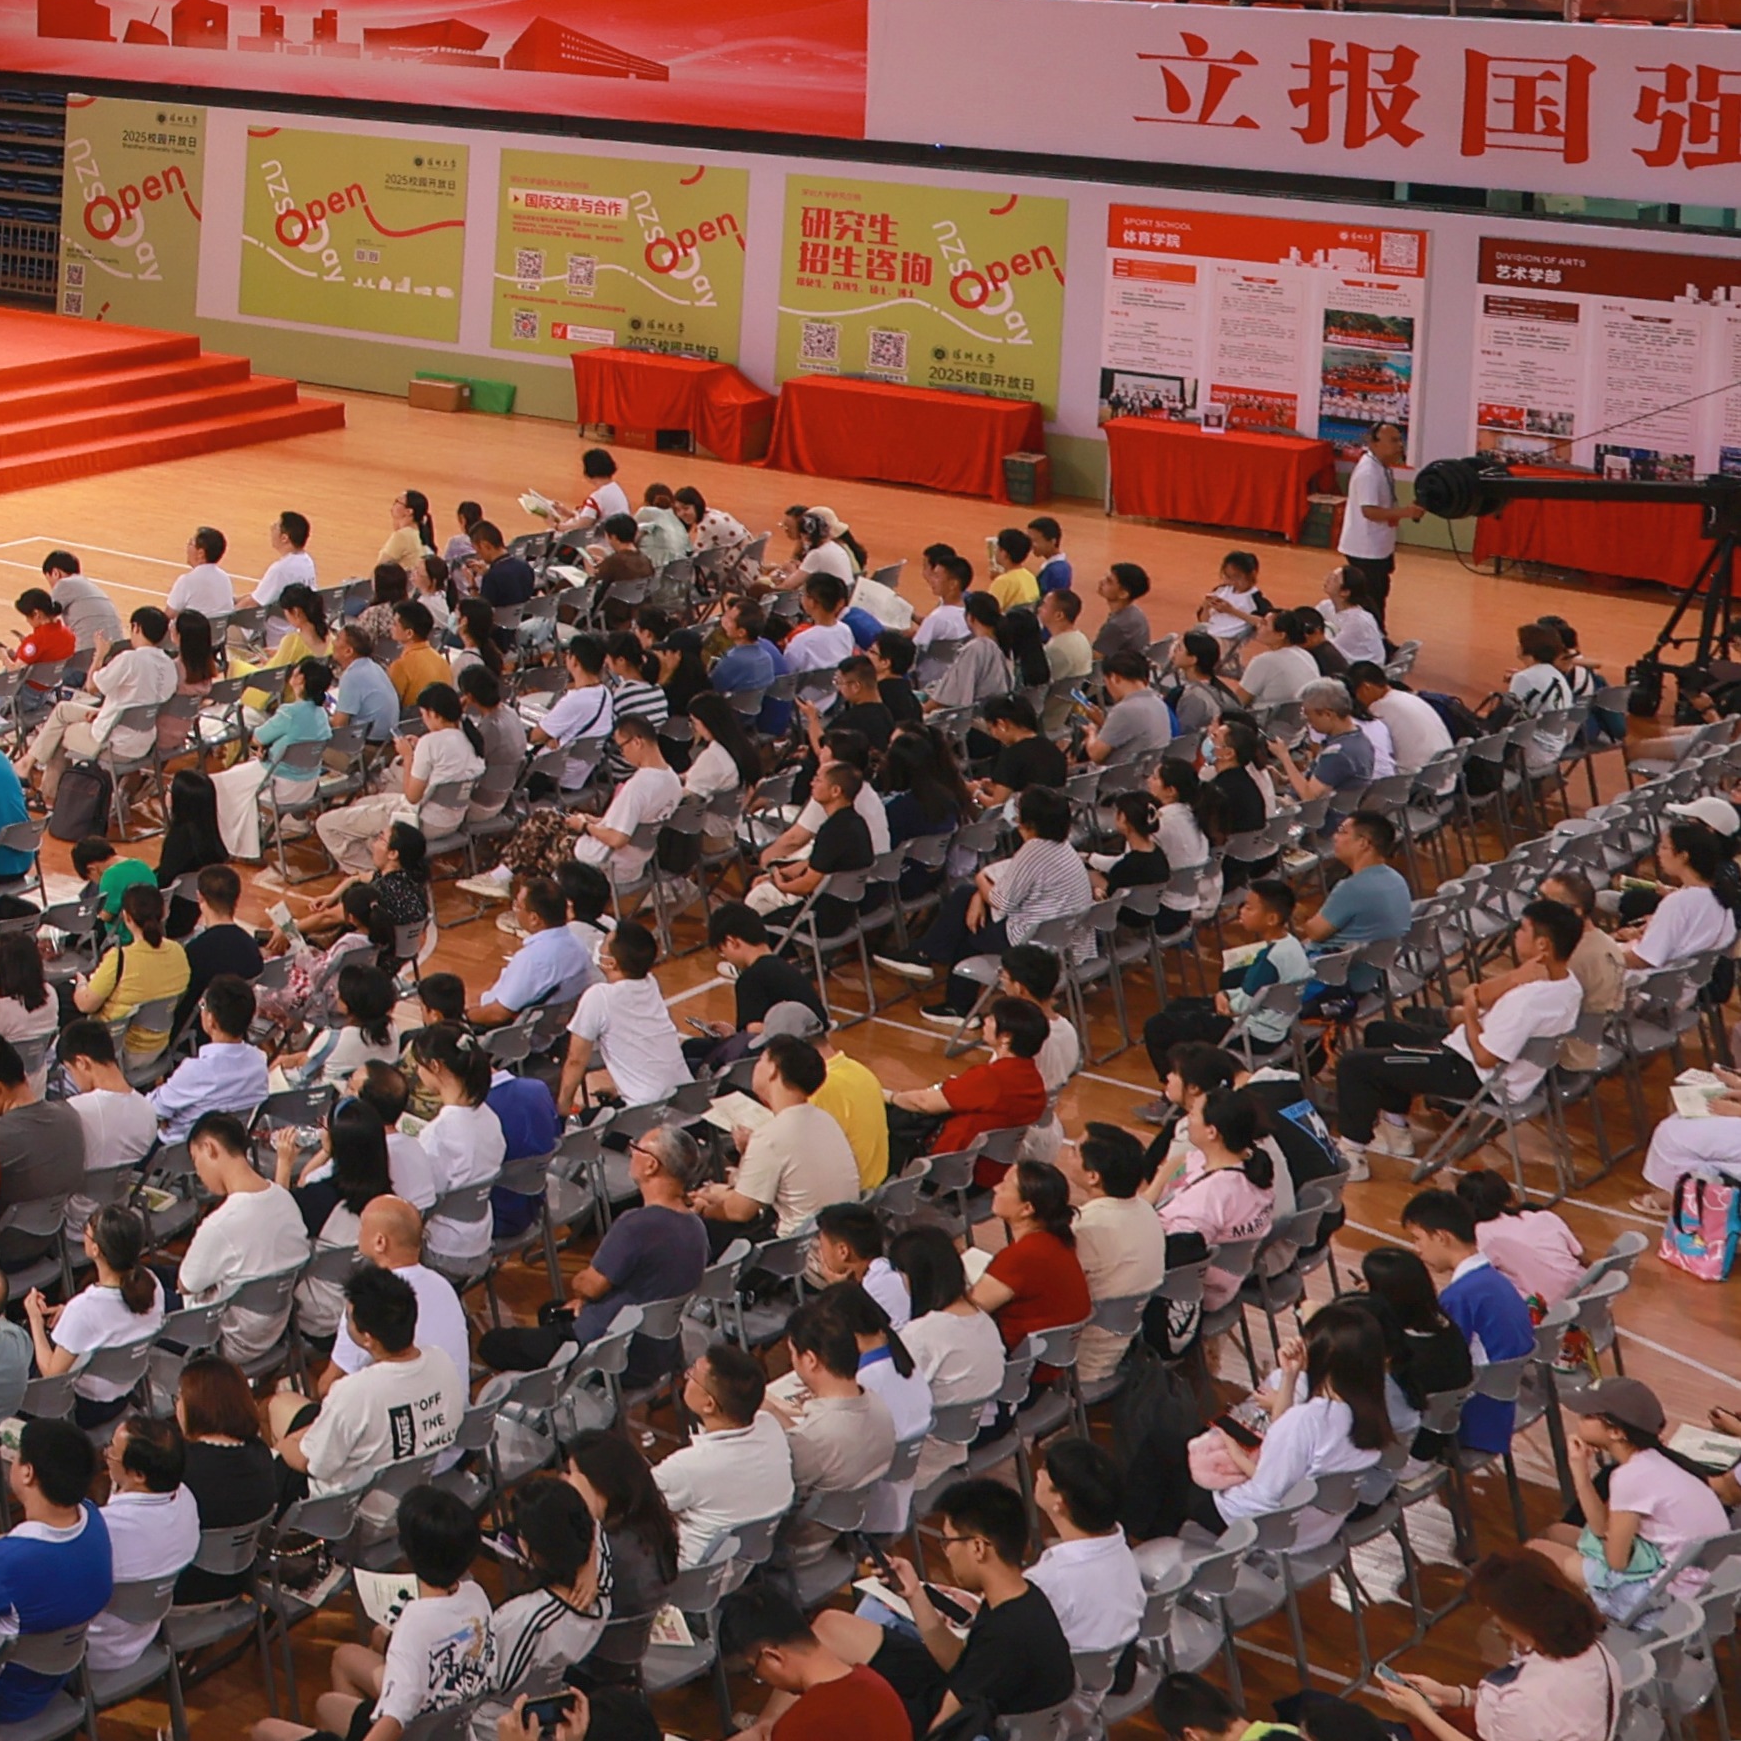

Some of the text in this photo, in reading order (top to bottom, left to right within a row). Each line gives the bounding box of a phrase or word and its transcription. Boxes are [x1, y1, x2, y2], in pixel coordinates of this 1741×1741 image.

[524, 192, 622, 216] 国际交流与合作
[801, 206, 899, 247] 研究生
[1122, 216, 1192, 232] SPORT SCHOOL
[1122, 228, 1181, 248] 体育学院
[798, 241, 933, 287] 招生咨询
[1495, 251, 1586, 268] DIVISION OF ARTS
[1495, 263, 1562, 284] 艺术学部
[928, 366, 1036, 392] 2025校园开放日
[422, 1415, 446, 1433] THE
[396, 1418, 411, 1457] VANS
